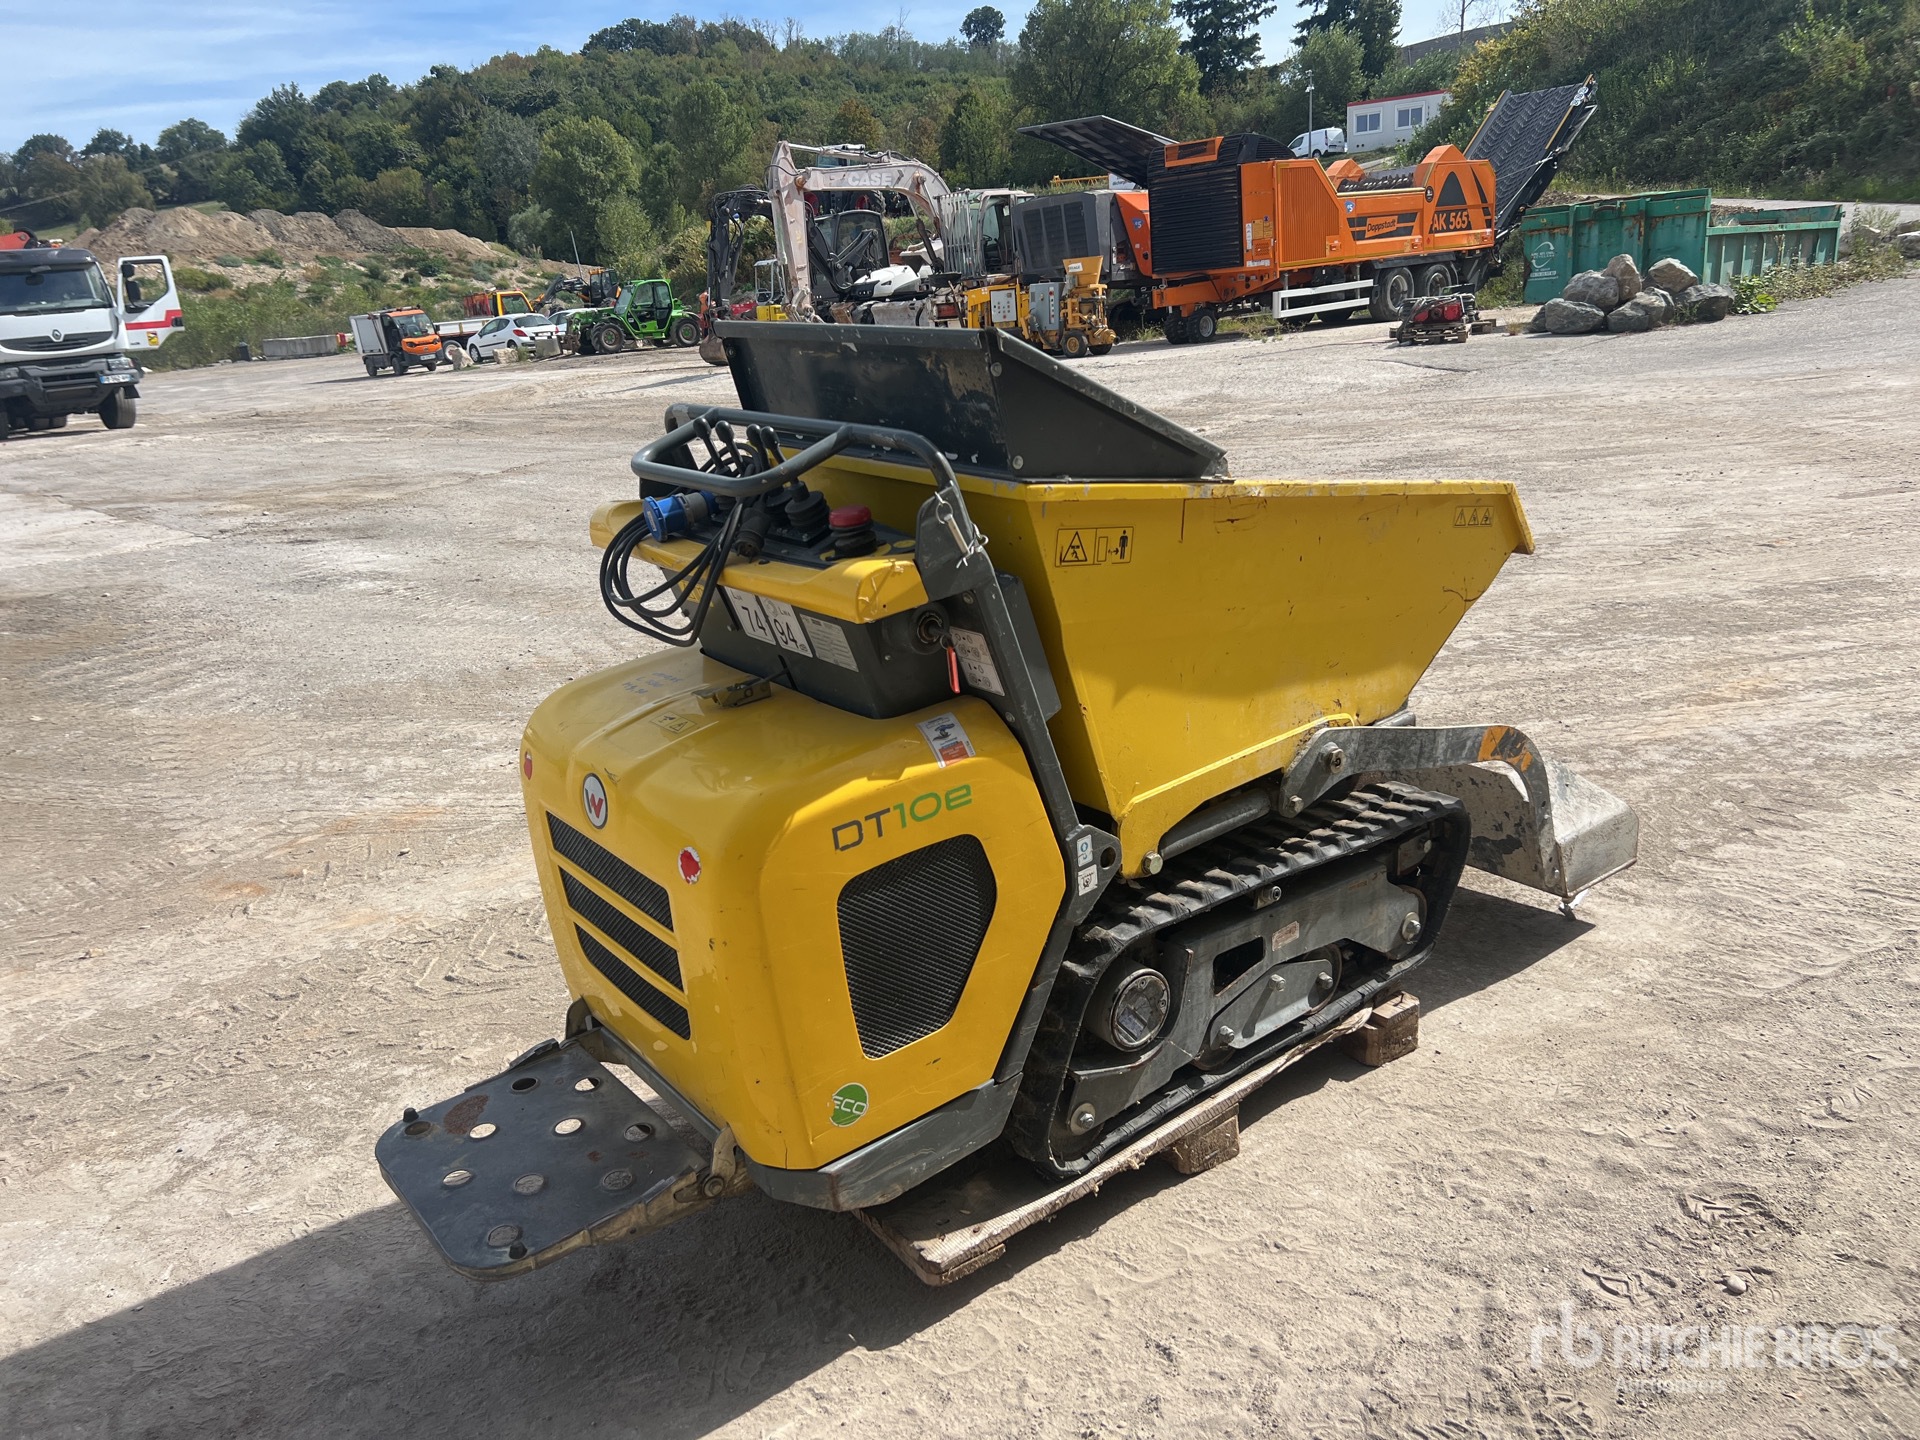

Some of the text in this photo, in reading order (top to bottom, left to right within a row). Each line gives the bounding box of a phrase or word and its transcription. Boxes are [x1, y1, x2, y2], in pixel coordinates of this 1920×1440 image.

[848, 171, 892, 186] CASE
[1367, 218, 1396, 233] Doppstadt
[1432, 211, 1469, 231] AK 565
[741, 605, 768, 637] 74
[773, 618, 799, 649] 94
[832, 784, 973, 852] DT10e
[832, 1095, 868, 1116] ECO
